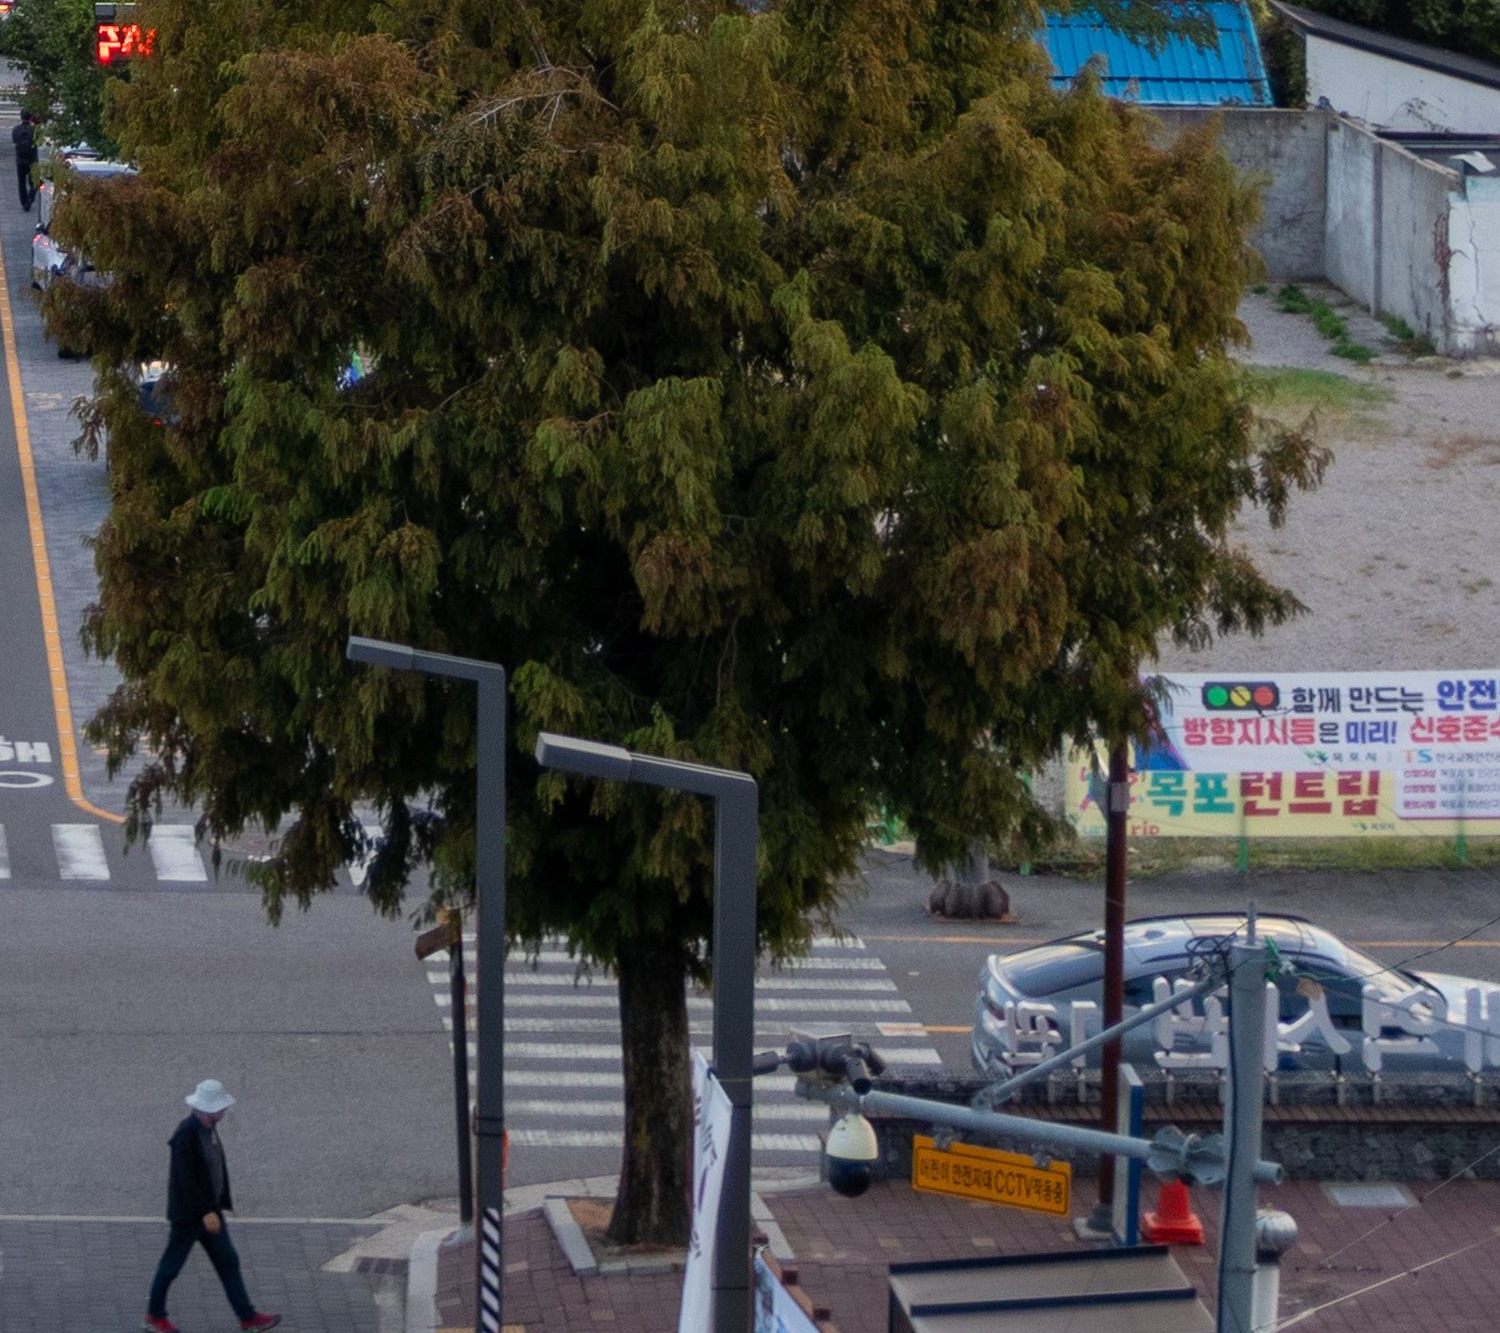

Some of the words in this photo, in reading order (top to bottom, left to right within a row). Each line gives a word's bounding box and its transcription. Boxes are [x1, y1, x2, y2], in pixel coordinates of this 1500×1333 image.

[1292, 687, 1341, 713] 함께
[1349, 686, 1424, 712] 만드는
[1183, 717, 1338, 746] 방향지시등은
[1346, 721, 1397, 744] 미리!
[1403, 749, 1433, 764] TS
[920, 1159, 949, 1181] 어린이
